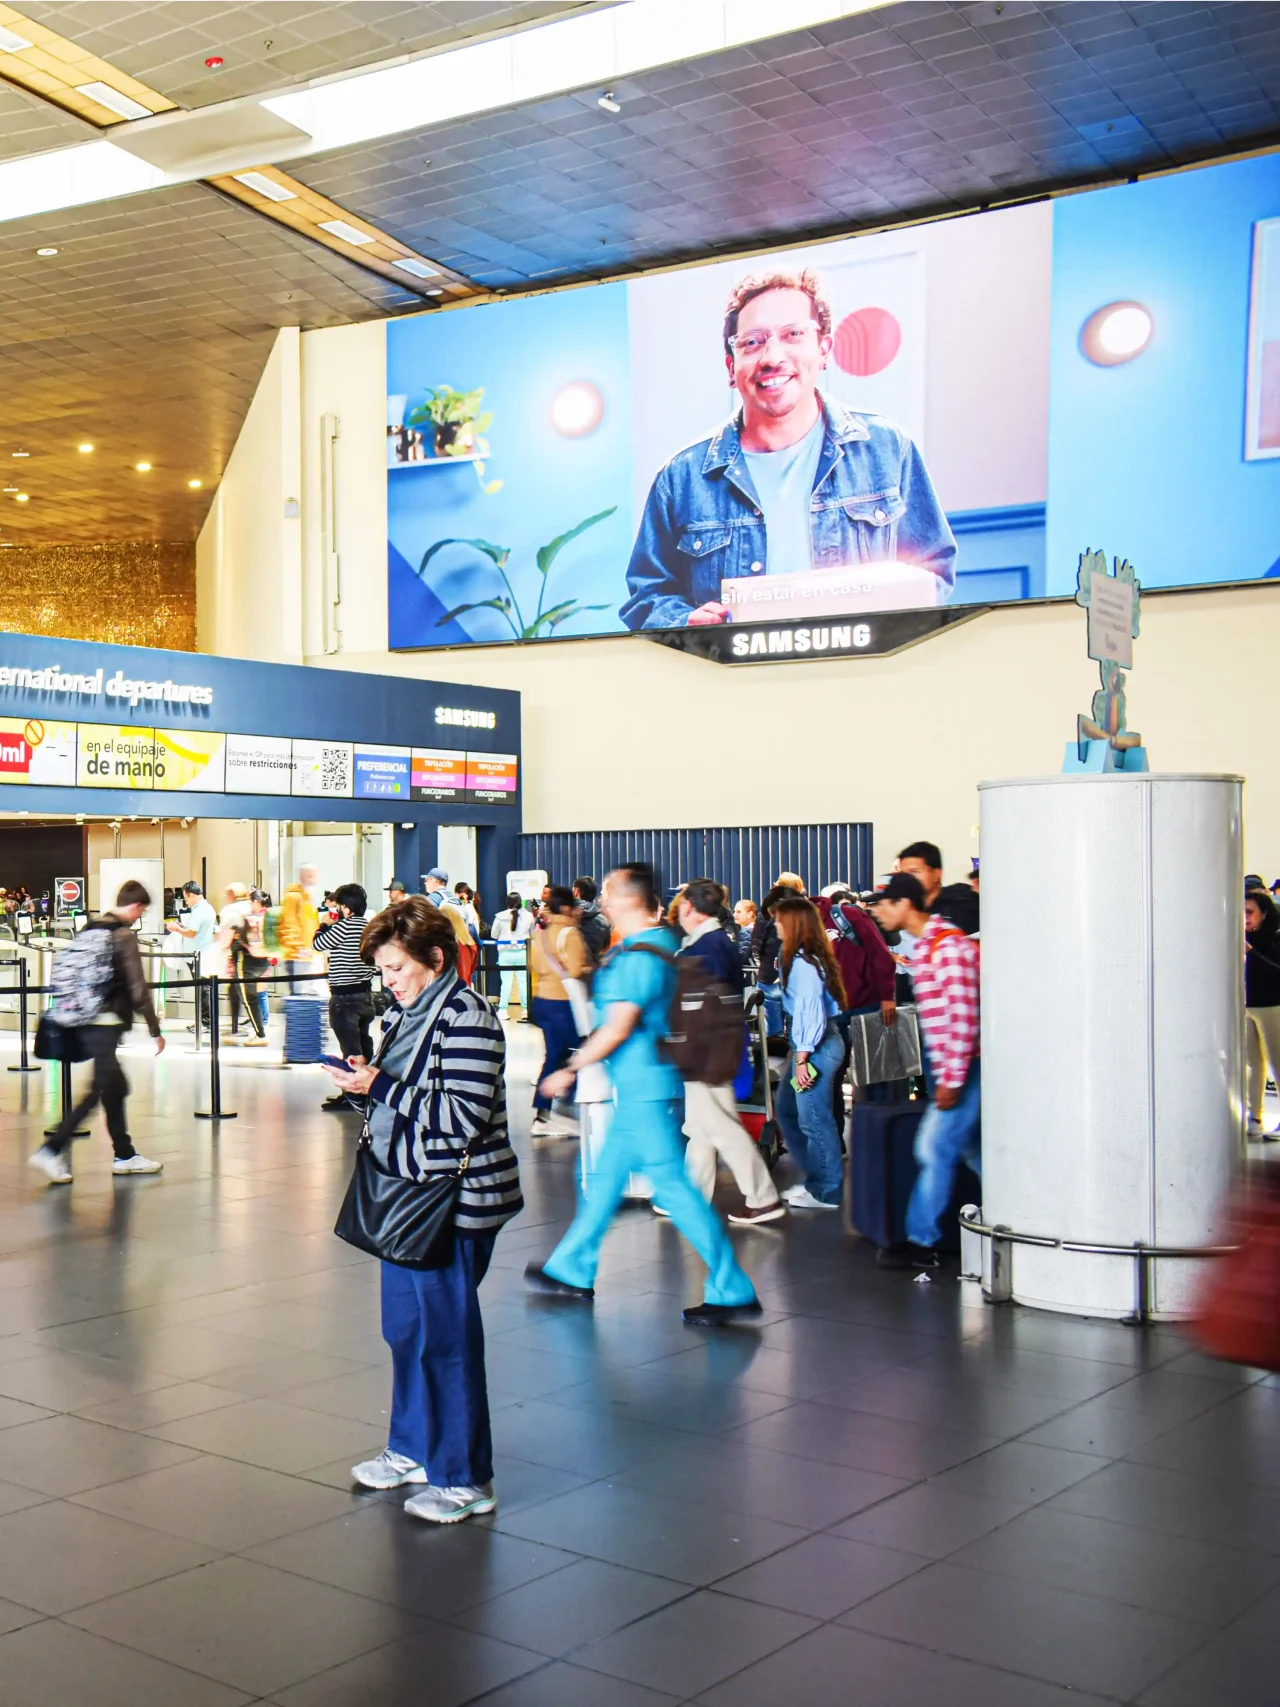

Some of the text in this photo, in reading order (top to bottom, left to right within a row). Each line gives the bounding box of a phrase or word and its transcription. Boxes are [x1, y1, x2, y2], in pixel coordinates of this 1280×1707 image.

[732, 624, 870, 656] SAMSUNG
[105, 670, 213, 706] departures
[435, 705, 496, 729] SAMSUNG
[87, 739, 166, 759] en el equipaje
[87, 753, 166, 778] de mano
[228, 758, 298, 770] sobre restricciones
[357, 760, 408, 774] PREFERENCIAL
